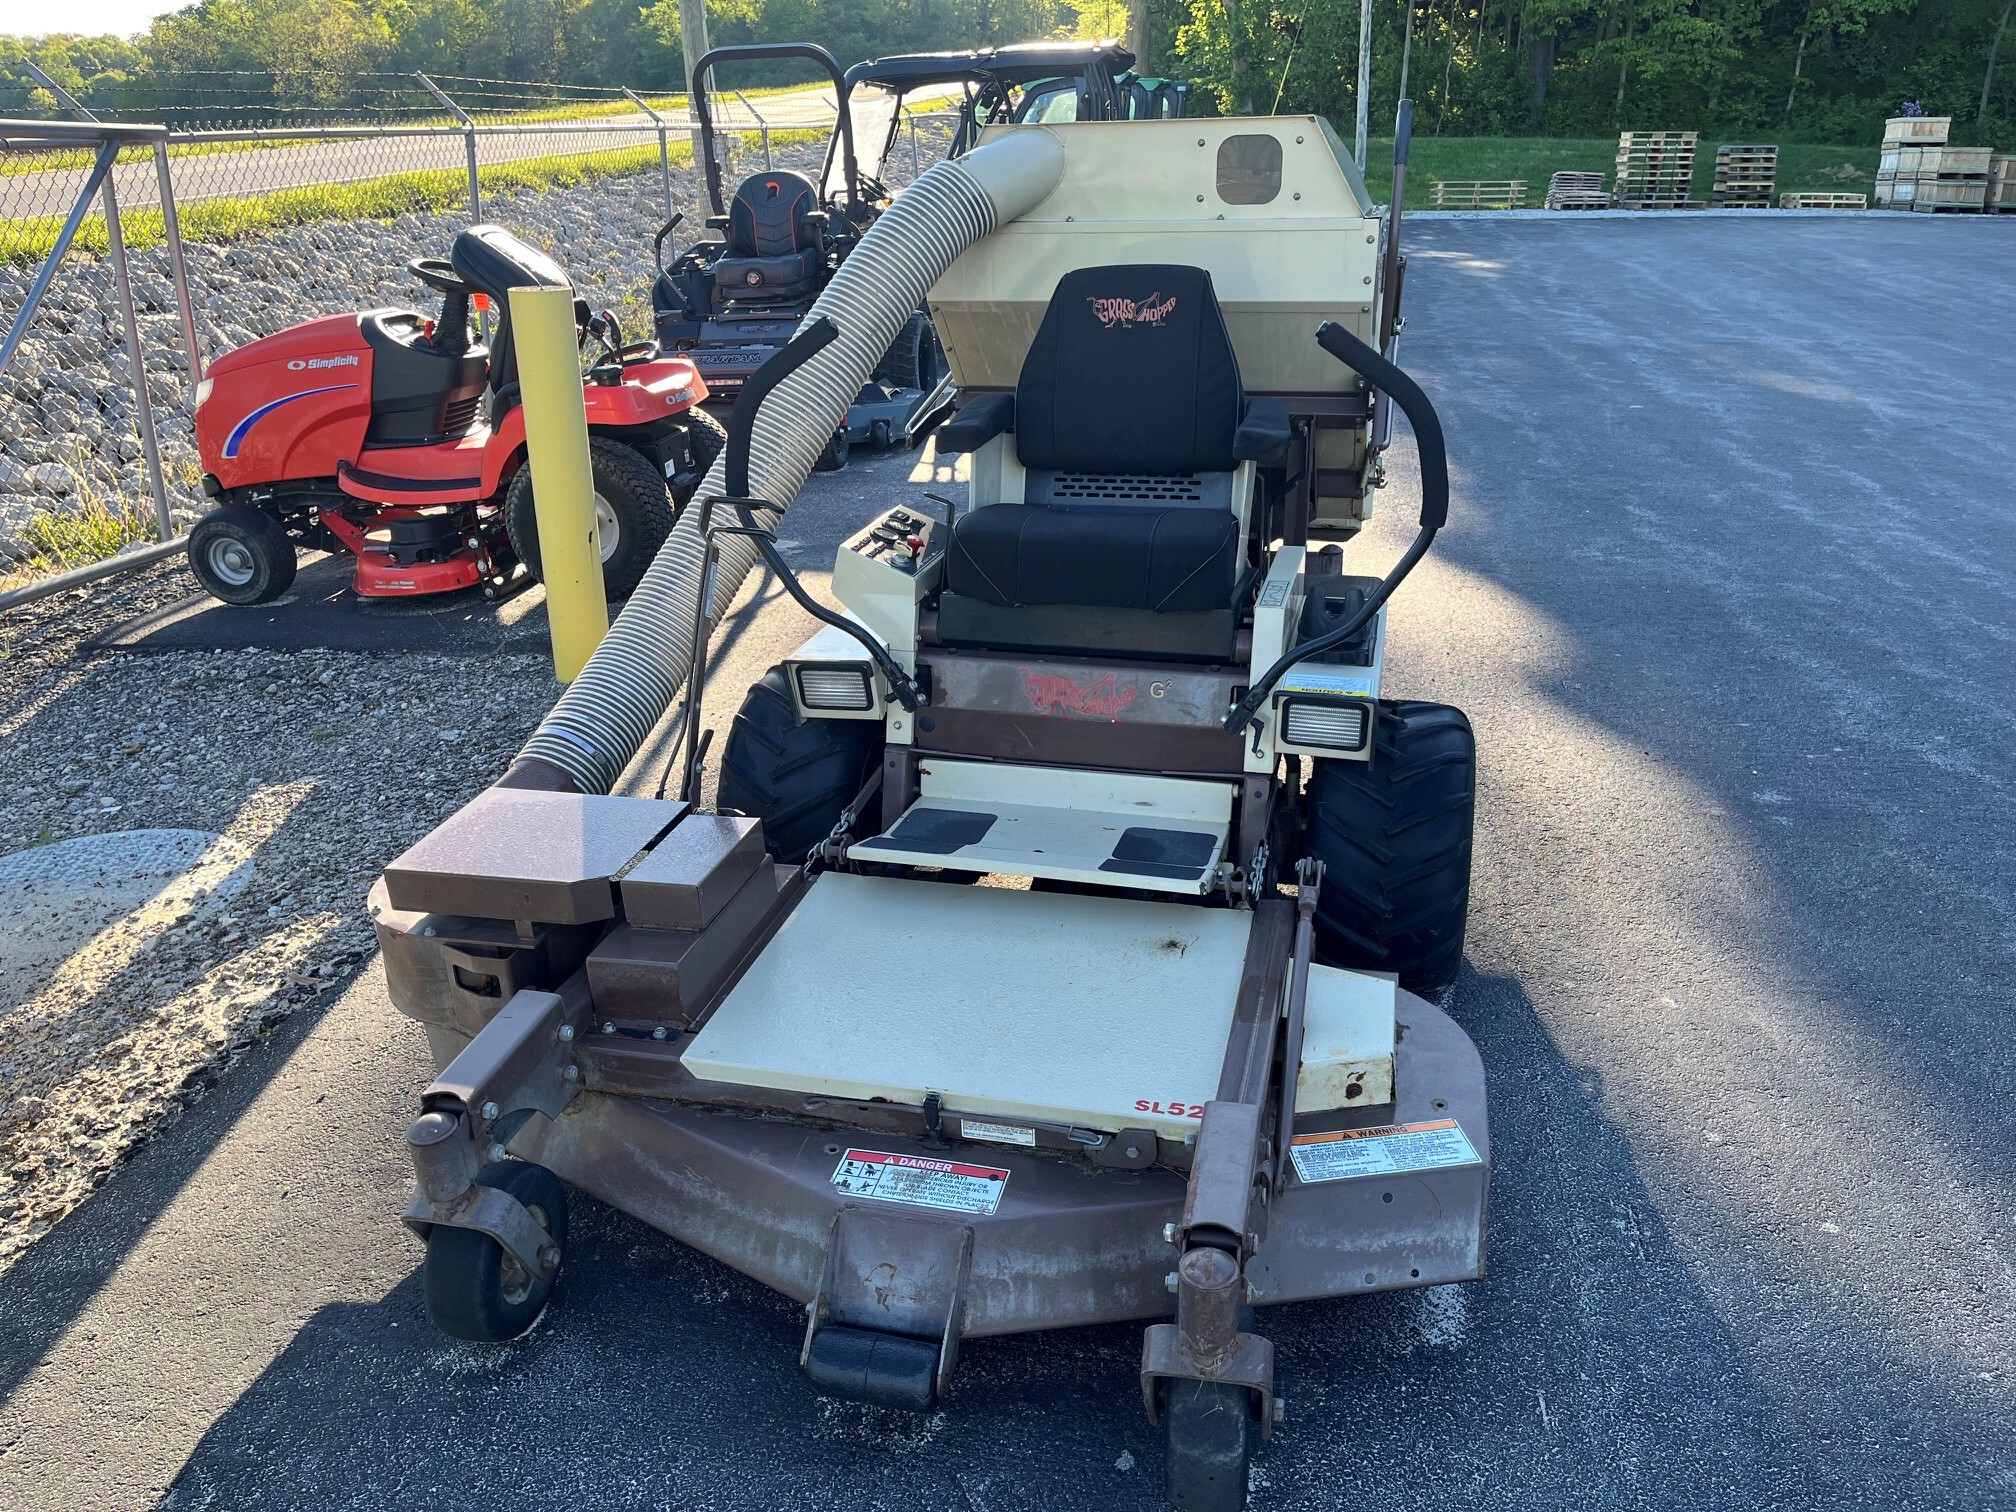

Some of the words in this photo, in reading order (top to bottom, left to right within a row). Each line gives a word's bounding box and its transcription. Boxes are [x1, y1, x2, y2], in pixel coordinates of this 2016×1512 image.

[308, 355, 359, 369] Simplicity
[1134, 1099, 1203, 1119] SL52
[1356, 1126, 1408, 1138] WARNING
[898, 1157, 953, 1172] DANGER
[920, 1169, 940, 1177] KEEP
[941, 1171, 968, 1182] AWAY!
[932, 1181, 960, 1190] THROWN
[961, 1186, 989, 1194] OBJECTS
[954, 1180, 978, 1188] INJURY
[928, 1190, 957, 1199] WITHOUT
[957, 1195, 995, 1205] DISCHARGE
